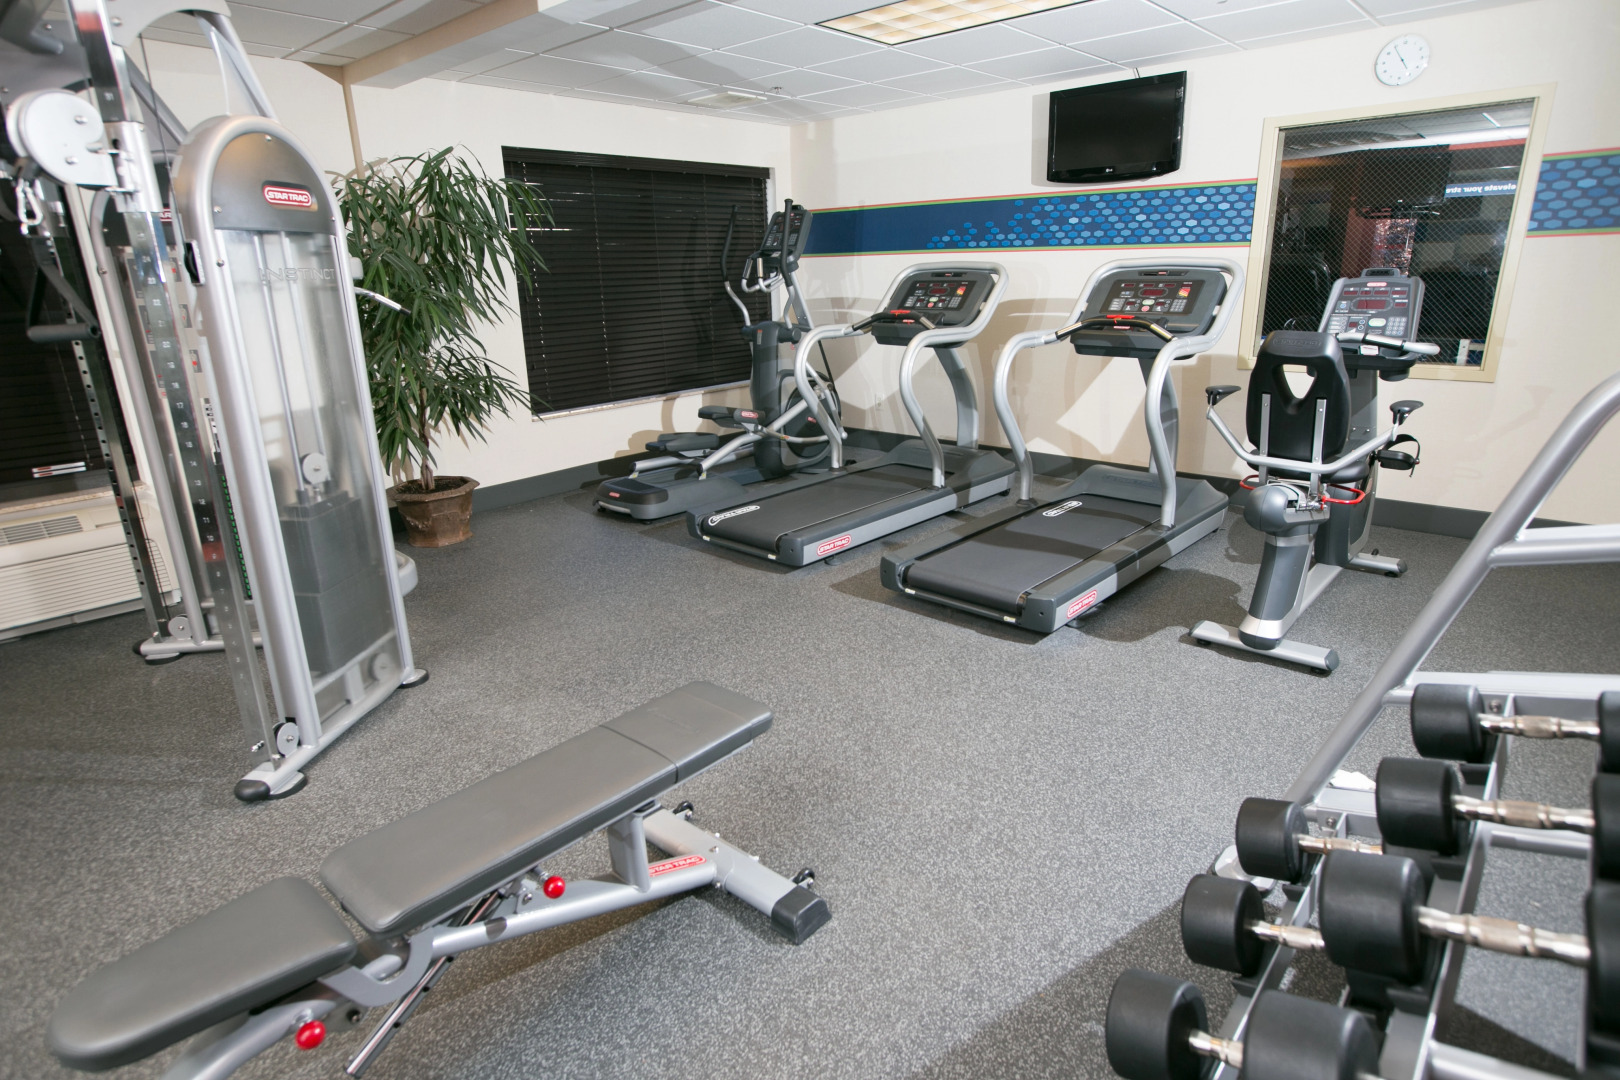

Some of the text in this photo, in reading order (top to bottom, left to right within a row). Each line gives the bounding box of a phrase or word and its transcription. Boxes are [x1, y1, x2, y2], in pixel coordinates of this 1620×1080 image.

[268, 191, 309, 202] STAR TRAC
[819, 542, 834, 552] STAR
[672, 856, 700, 867] TRAC
